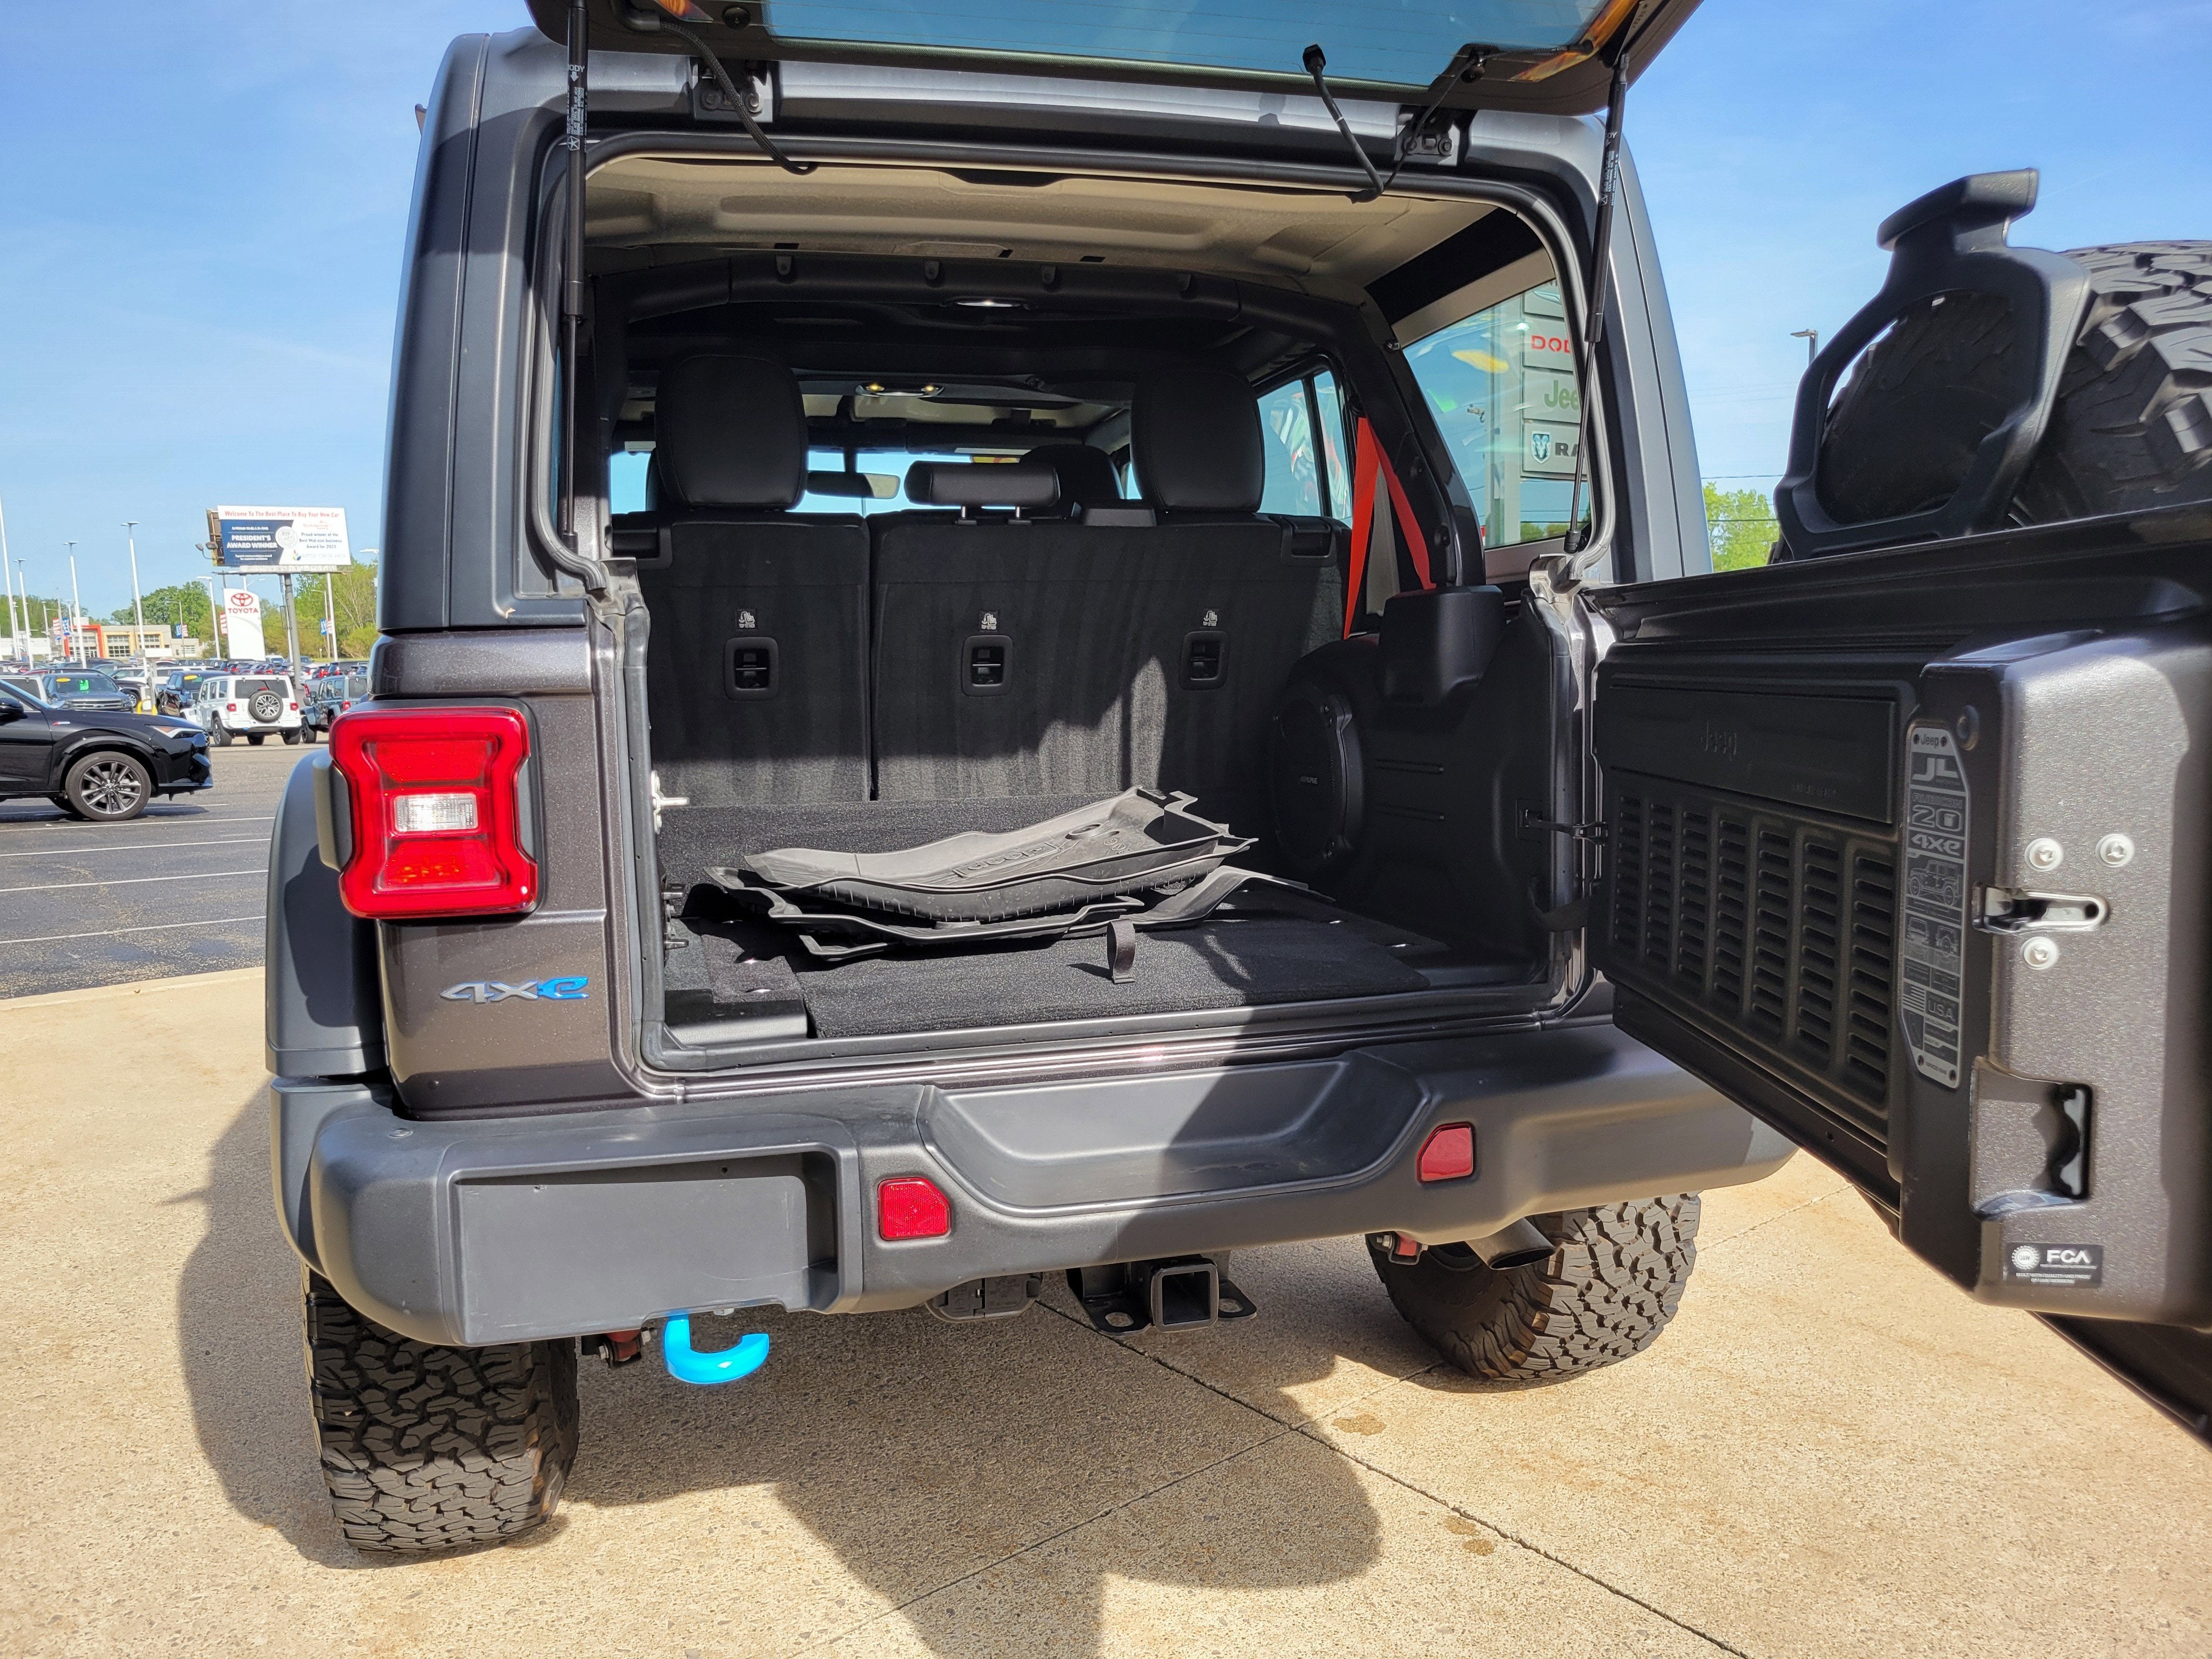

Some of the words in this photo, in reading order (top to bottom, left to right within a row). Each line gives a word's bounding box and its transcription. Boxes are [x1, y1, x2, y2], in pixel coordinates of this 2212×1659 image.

[1921, 733, 1939, 748] Jeep
[1911, 757, 1959, 781] JL
[2046, 1249, 2091, 1263] FCA
